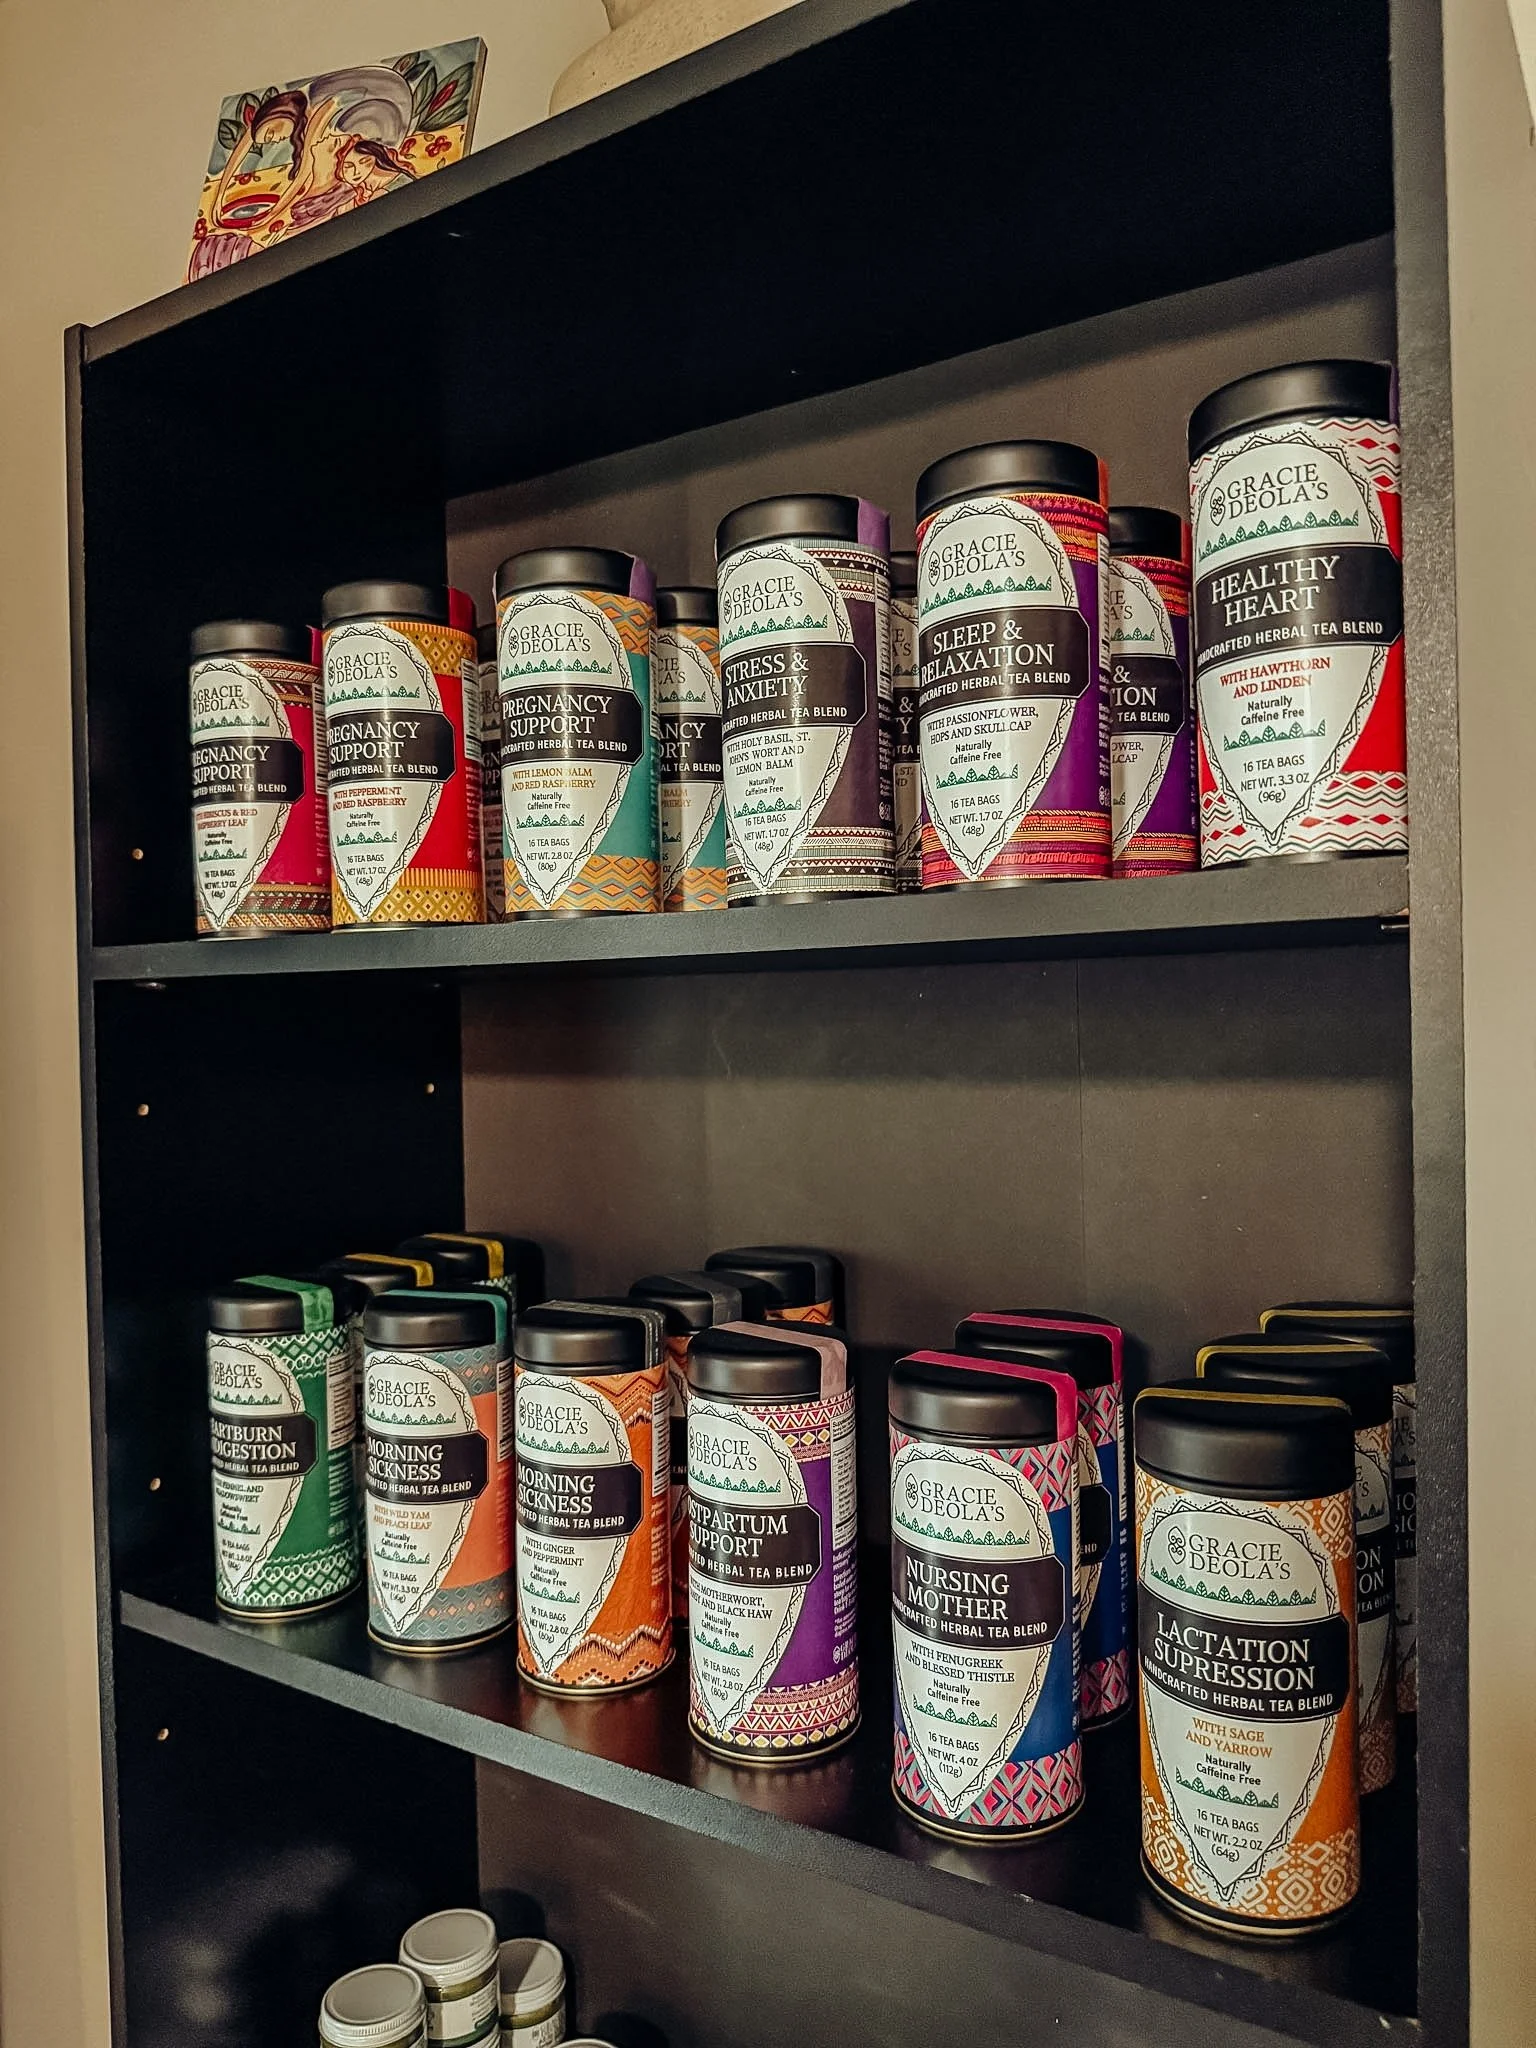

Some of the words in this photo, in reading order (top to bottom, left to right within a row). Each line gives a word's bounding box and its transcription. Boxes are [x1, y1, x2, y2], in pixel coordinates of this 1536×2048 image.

[1227, 463, 1319, 500] GRACIE
[1229, 483, 1329, 519] DEOLA'S
[942, 534, 1017, 564] GRACIE
[942, 551, 1025, 582] DEOLA'S
[732, 576, 795, 603] GRACIE
[1211, 556, 1340, 604] HEALTHY
[734, 592, 803, 619] DEOLA'S
[1225, 585, 1320, 626] HEART
[520, 622, 584, 640] GRACIE
[934, 621, 996, 655] SLEEP
[1003, 620, 1023, 639] &
[1255, 625, 1307, 645] HERBAL
[1312, 623, 1338, 636] TEA
[1342, 621, 1383, 634] BLEND
[521, 638, 591, 655] DEOLA'S
[336, 651, 391, 670] GRACIE
[725, 653, 785, 686] STRESS
[792, 652, 809, 671] &
[921, 644, 1054, 687] RELAXATION
[1220, 669, 1248, 687] WITH
[1250, 657, 1331, 679] HAWTHORN
[337, 666, 398, 683] DEOLA'S
[962, 675, 1004, 690] HERBAL
[1008, 674, 1030, 684] TEA
[1034, 673, 1070, 683] BLEND
[198, 685, 243, 701] GRACIE
[727, 676, 809, 709] ANXIETY
[1233, 683, 1258, 699] AND
[1261, 675, 1312, 692] LINDEN
[198, 698, 250, 715] DEOLA'S
[502, 694, 612, 719] PREGNANCY
[750, 709, 787, 723] HERBAL
[790, 707, 809, 718] TEA
[814, 707, 847, 717] BLEND
[1248, 695, 1292, 712] Naturally
[510, 716, 595, 738] SUPPORT
[927, 720, 944, 732] WITH
[946, 707, 1039, 726] PASSIONFLOWER,
[1241, 712, 1278, 726] Caffeine
[1282, 708, 1305, 719] Free
[741, 736, 762, 749] HOLY
[930, 732, 950, 744] HOPS
[951, 727, 972, 739] AND
[974, 721, 1032, 735] SKULLCAP
[330, 742, 404, 764] SUPPORT
[538, 740, 573, 749] HERBAL
[576, 740, 594, 748] TEA
[598, 740, 627, 752] BLEND
[752, 748, 779, 759] WORT
[782, 746, 804, 755] AND
[353, 765, 384, 775] HERBAL
[387, 765, 404, 773] TEA
[408, 765, 438, 774] BLEND
[736, 762, 762, 775] LEMON
[766, 759, 793, 769] BALM
[1243, 762, 1254, 773] 16
[1256, 759, 1275, 770] TEA
[1278, 755, 1305, 767] BAGS
[209, 784, 236, 794] HERBAL
[239, 784, 255, 792] TEA
[258, 784, 287, 792] BLEND
[1241, 779, 1256, 792] NET
[1278, 775, 1294, 786] 3.3
[1296, 773, 1310, 783] OZ
[1258, 789, 1286, 803] (96g)
[376, 1379, 430, 1395] GRACIE
[377, 1392, 436, 1407] DEOLA'S
[527, 1402, 582, 1421] GRACIE
[528, 1415, 588, 1434] DEOLA'S
[368, 1436, 443, 1462] MORNING
[695, 1432, 750, 1456] GRACIE
[252, 1464, 268, 1473] TEA
[270, 1462, 300, 1472] BLEND
[368, 1456, 442, 1480] SICKNESS
[696, 1447, 757, 1471] DEOLA'S
[389, 1484, 419, 1494] HERBAL
[422, 1485, 439, 1494] TEA
[442, 1481, 472, 1492] BLEND
[518, 1462, 595, 1494] MORNING
[519, 1483, 592, 1514] SICKNESS
[920, 1480, 997, 1505] GRACIE
[921, 1496, 1005, 1522] DEOLA'S
[538, 1514, 570, 1528] HERBAL
[573, 1518, 592, 1529] TEA
[594, 1516, 624, 1528] BLEND
[690, 1521, 763, 1557] SUPPORT
[1188, 1534, 1283, 1562] GRACIE
[707, 1559, 744, 1577] HERBAL
[749, 1567, 771, 1579] TEA
[776, 1564, 813, 1577] BLEND
[906, 1556, 1010, 1596] NURSING
[1189, 1553, 1291, 1580] DEOLA'S
[702, 1598, 719, 1611] AND
[718, 1604, 745, 1617] BLACK
[748, 1609, 773, 1620] HAW
[908, 1581, 1008, 1621] MOTHER
[940, 1621, 984, 1638] HERBAL
[988, 1626, 1010, 1638] TEA
[1013, 1622, 1048, 1637] BLEND
[1157, 1612, 1310, 1663] LACTATION
[911, 1640, 934, 1659] WITH
[936, 1650, 1003, 1669] FENUGREEK
[1155, 1638, 1315, 1691] SUPRESSION
[905, 1652, 921, 1666] AND
[922, 1661, 965, 1679] BLESSED
[967, 1671, 1015, 1683] THISTLE
[933, 1678, 970, 1696] Naturally
[1145, 1656, 1208, 1701] HANDCRAFTED
[1213, 1692, 1265, 1711] HERBAL
[1270, 1699, 1293, 1711] TEA
[1298, 1694, 1333, 1710] BLEND
[928, 1688, 959, 1704] Caffeine
[961, 1697, 980, 1706] Free
[929, 1731, 937, 1742] 16
[939, 1735, 954, 1745] TEA
[956, 1740, 979, 1751] BAGS
[1192, 1717, 1226, 1736] WITH
[1229, 1727, 1265, 1742] SAGE
[928, 1746, 942, 1759] NET
[960, 1756, 966, 1765] 4
[967, 1757, 978, 1766] OZ
[1186, 1731, 1211, 1746] AND
[1215, 1740, 1272, 1758] YARROW
[939, 1762, 963, 1778] (112g)
[1196, 1763, 1235, 1782] Caffeine
[1239, 1774, 1261, 1786] Free
[1205, 1753, 1251, 1774] Naturally
[1197, 1809, 1207, 1821] 16
[1210, 1814, 1229, 1827] TEA
[1232, 1819, 1259, 1832] BAGS
[1194, 1824, 1211, 1838] NET
[1232, 1837, 1248, 1848] 2.2
[1249, 1840, 1262, 1850] OZ
[1211, 1844, 1240, 1862] (64g)
